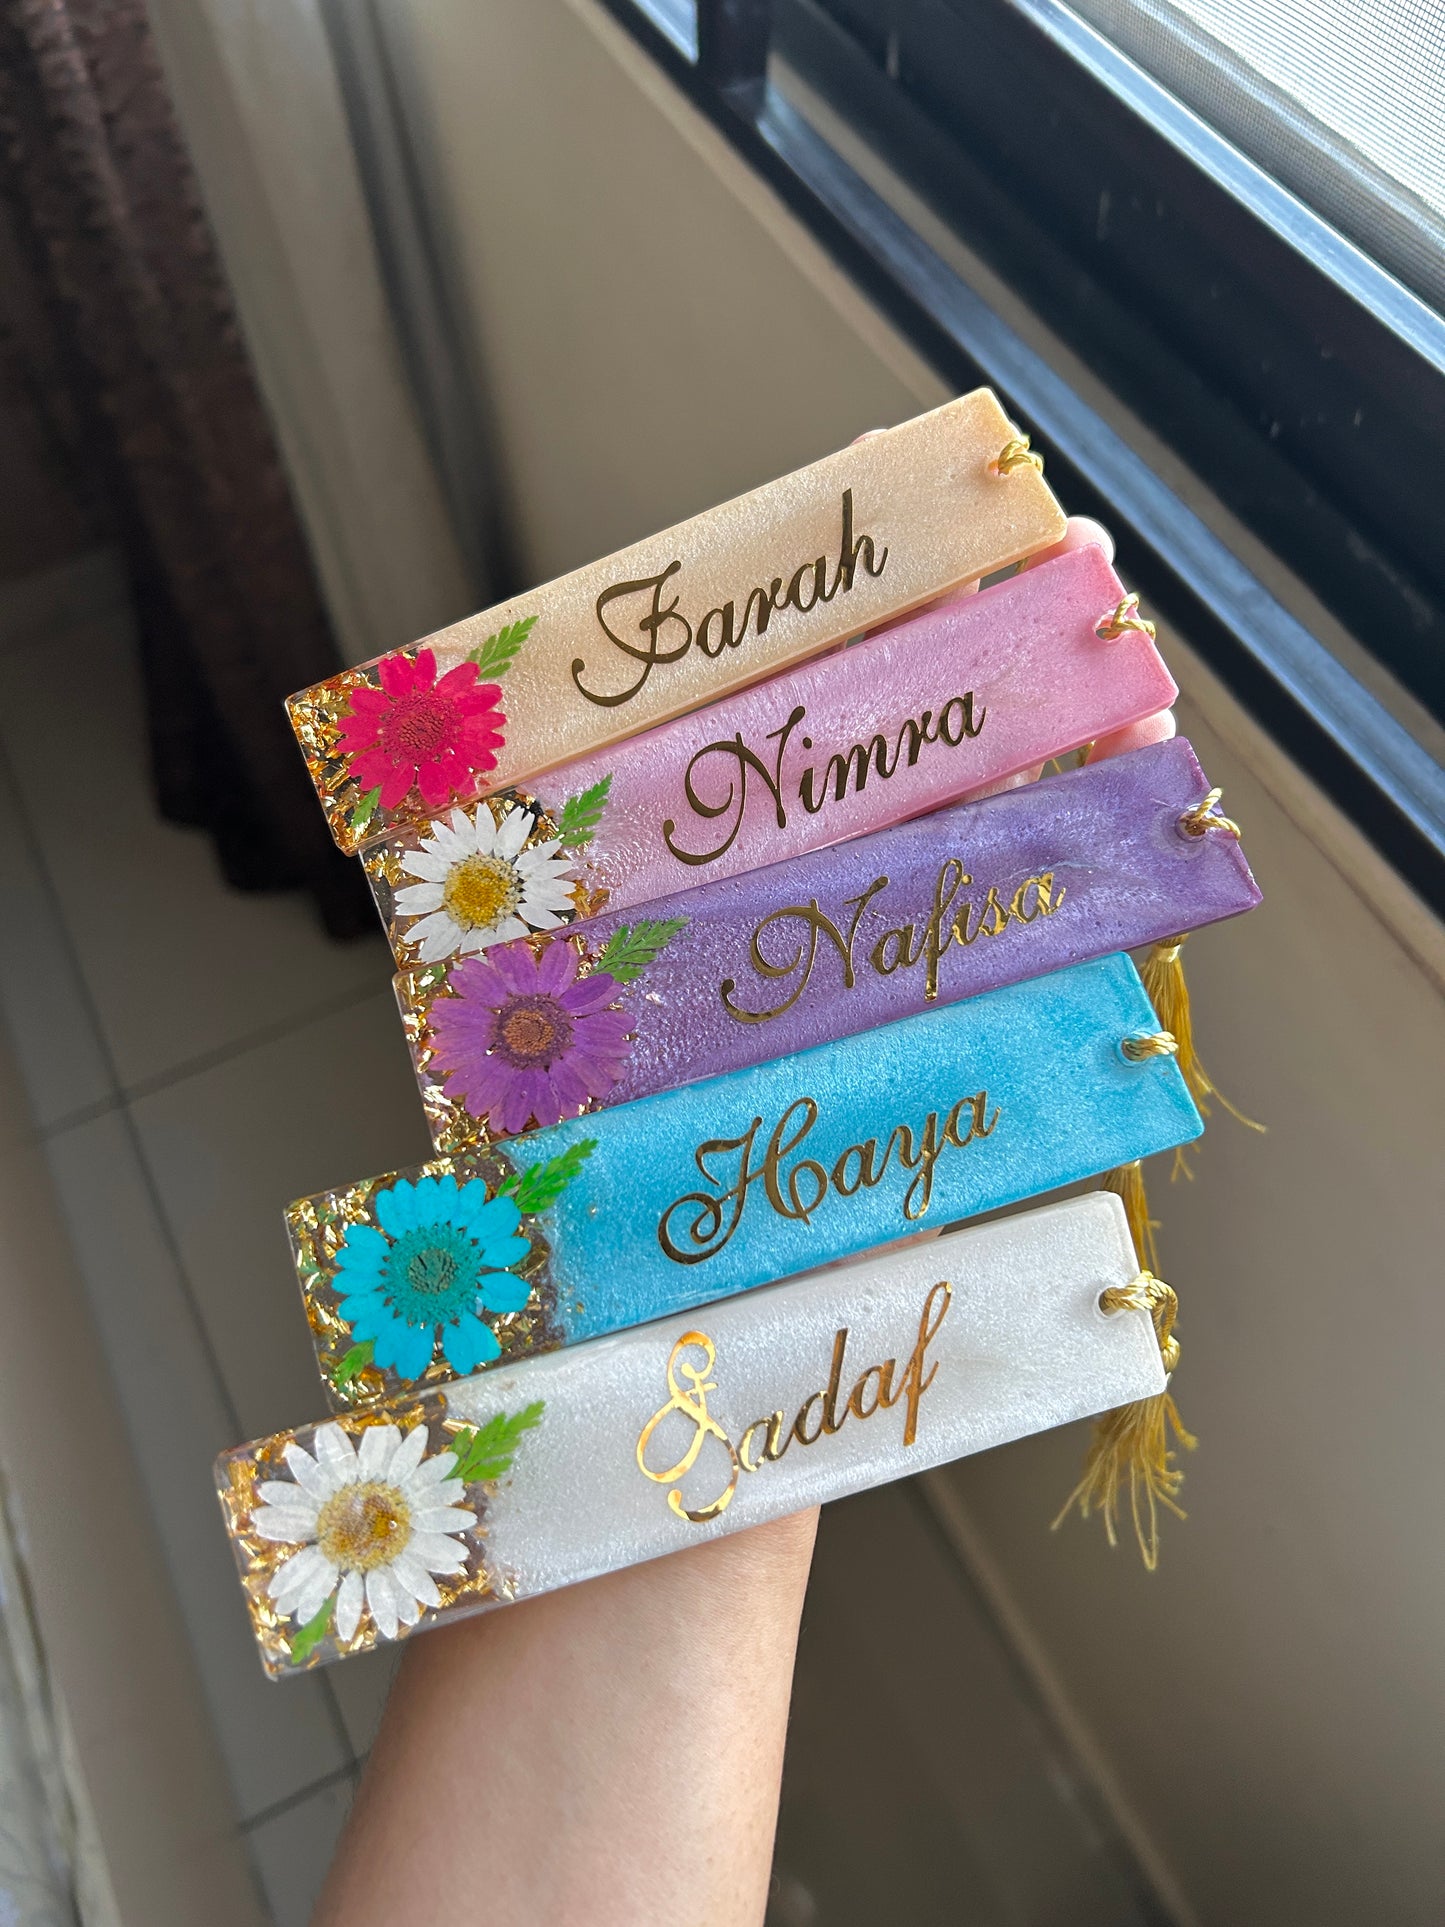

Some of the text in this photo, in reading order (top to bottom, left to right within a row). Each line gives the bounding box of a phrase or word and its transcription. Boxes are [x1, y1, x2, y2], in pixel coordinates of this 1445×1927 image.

[571, 487, 888, 707] Farah
[663, 691, 987, 866] Nimra
[720, 859, 1067, 1024] Nafisa
[657, 1090, 1001, 1265] Haya
[636, 1280, 952, 1523] Sadaf
